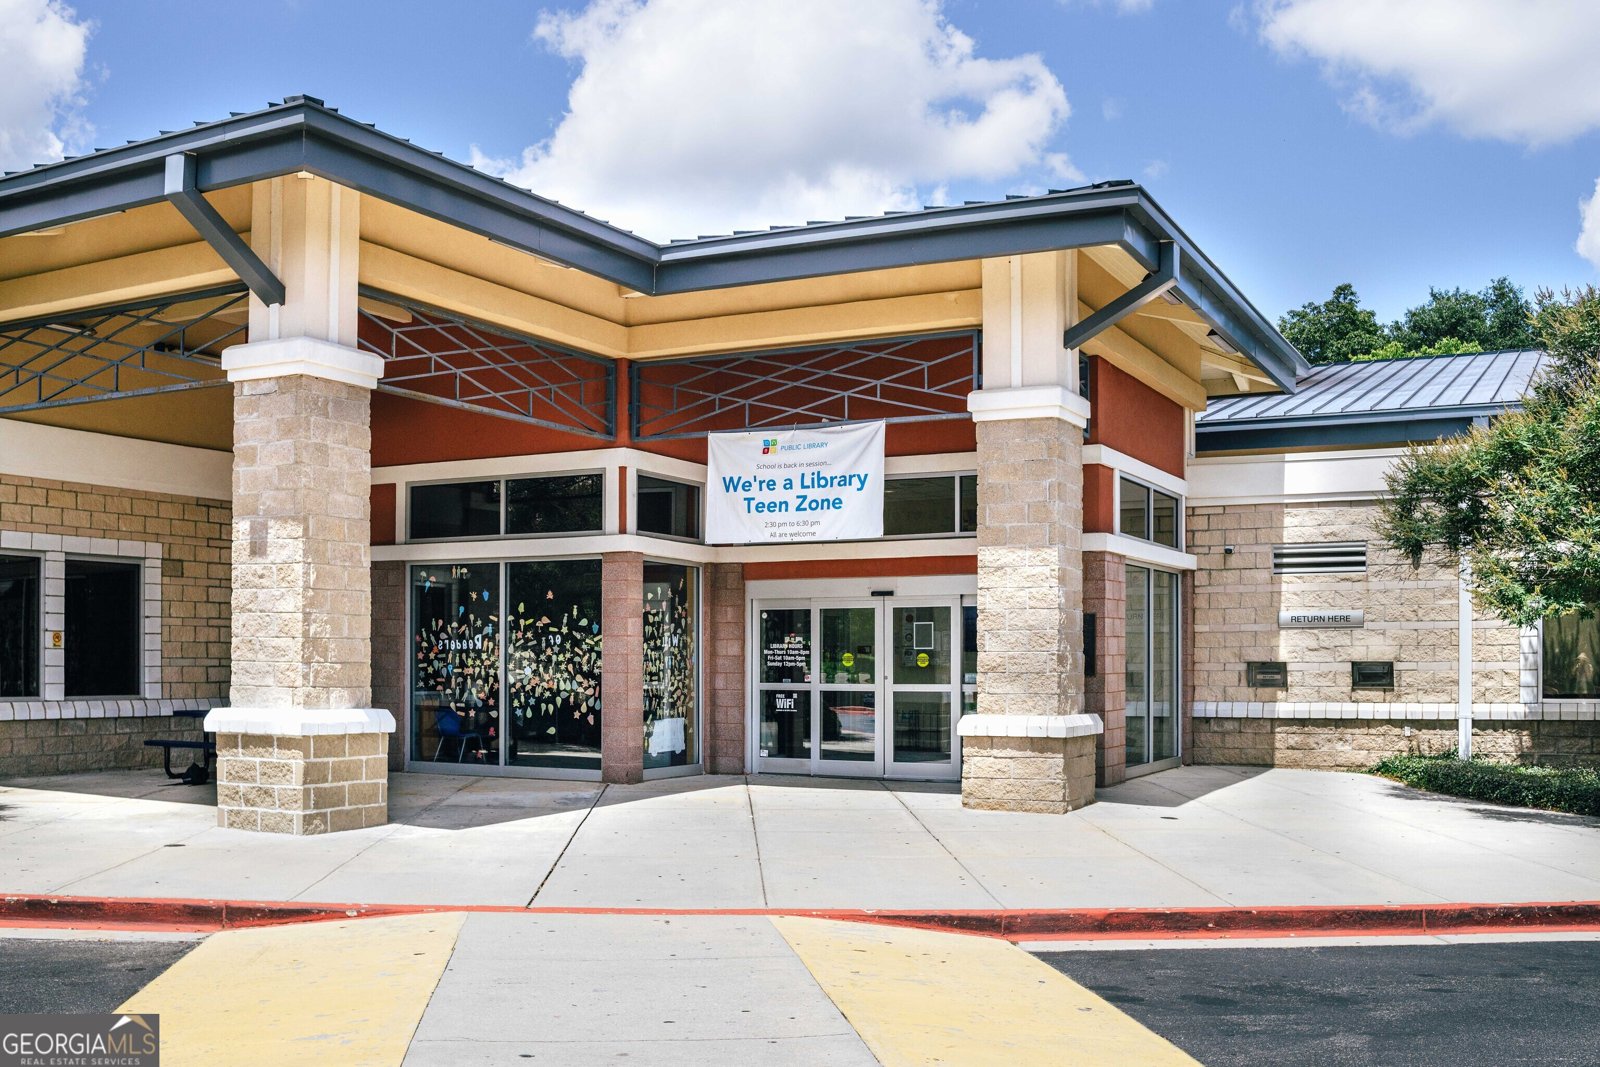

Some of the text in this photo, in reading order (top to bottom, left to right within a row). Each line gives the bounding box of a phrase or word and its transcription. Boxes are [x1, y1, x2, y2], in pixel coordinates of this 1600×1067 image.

[803, 442, 829, 450] LIBRARY
[722, 471, 869, 493] We're a Library
[743, 494, 843, 514] Teen Zone
[1290, 614, 1351, 623] RETURN HERE
